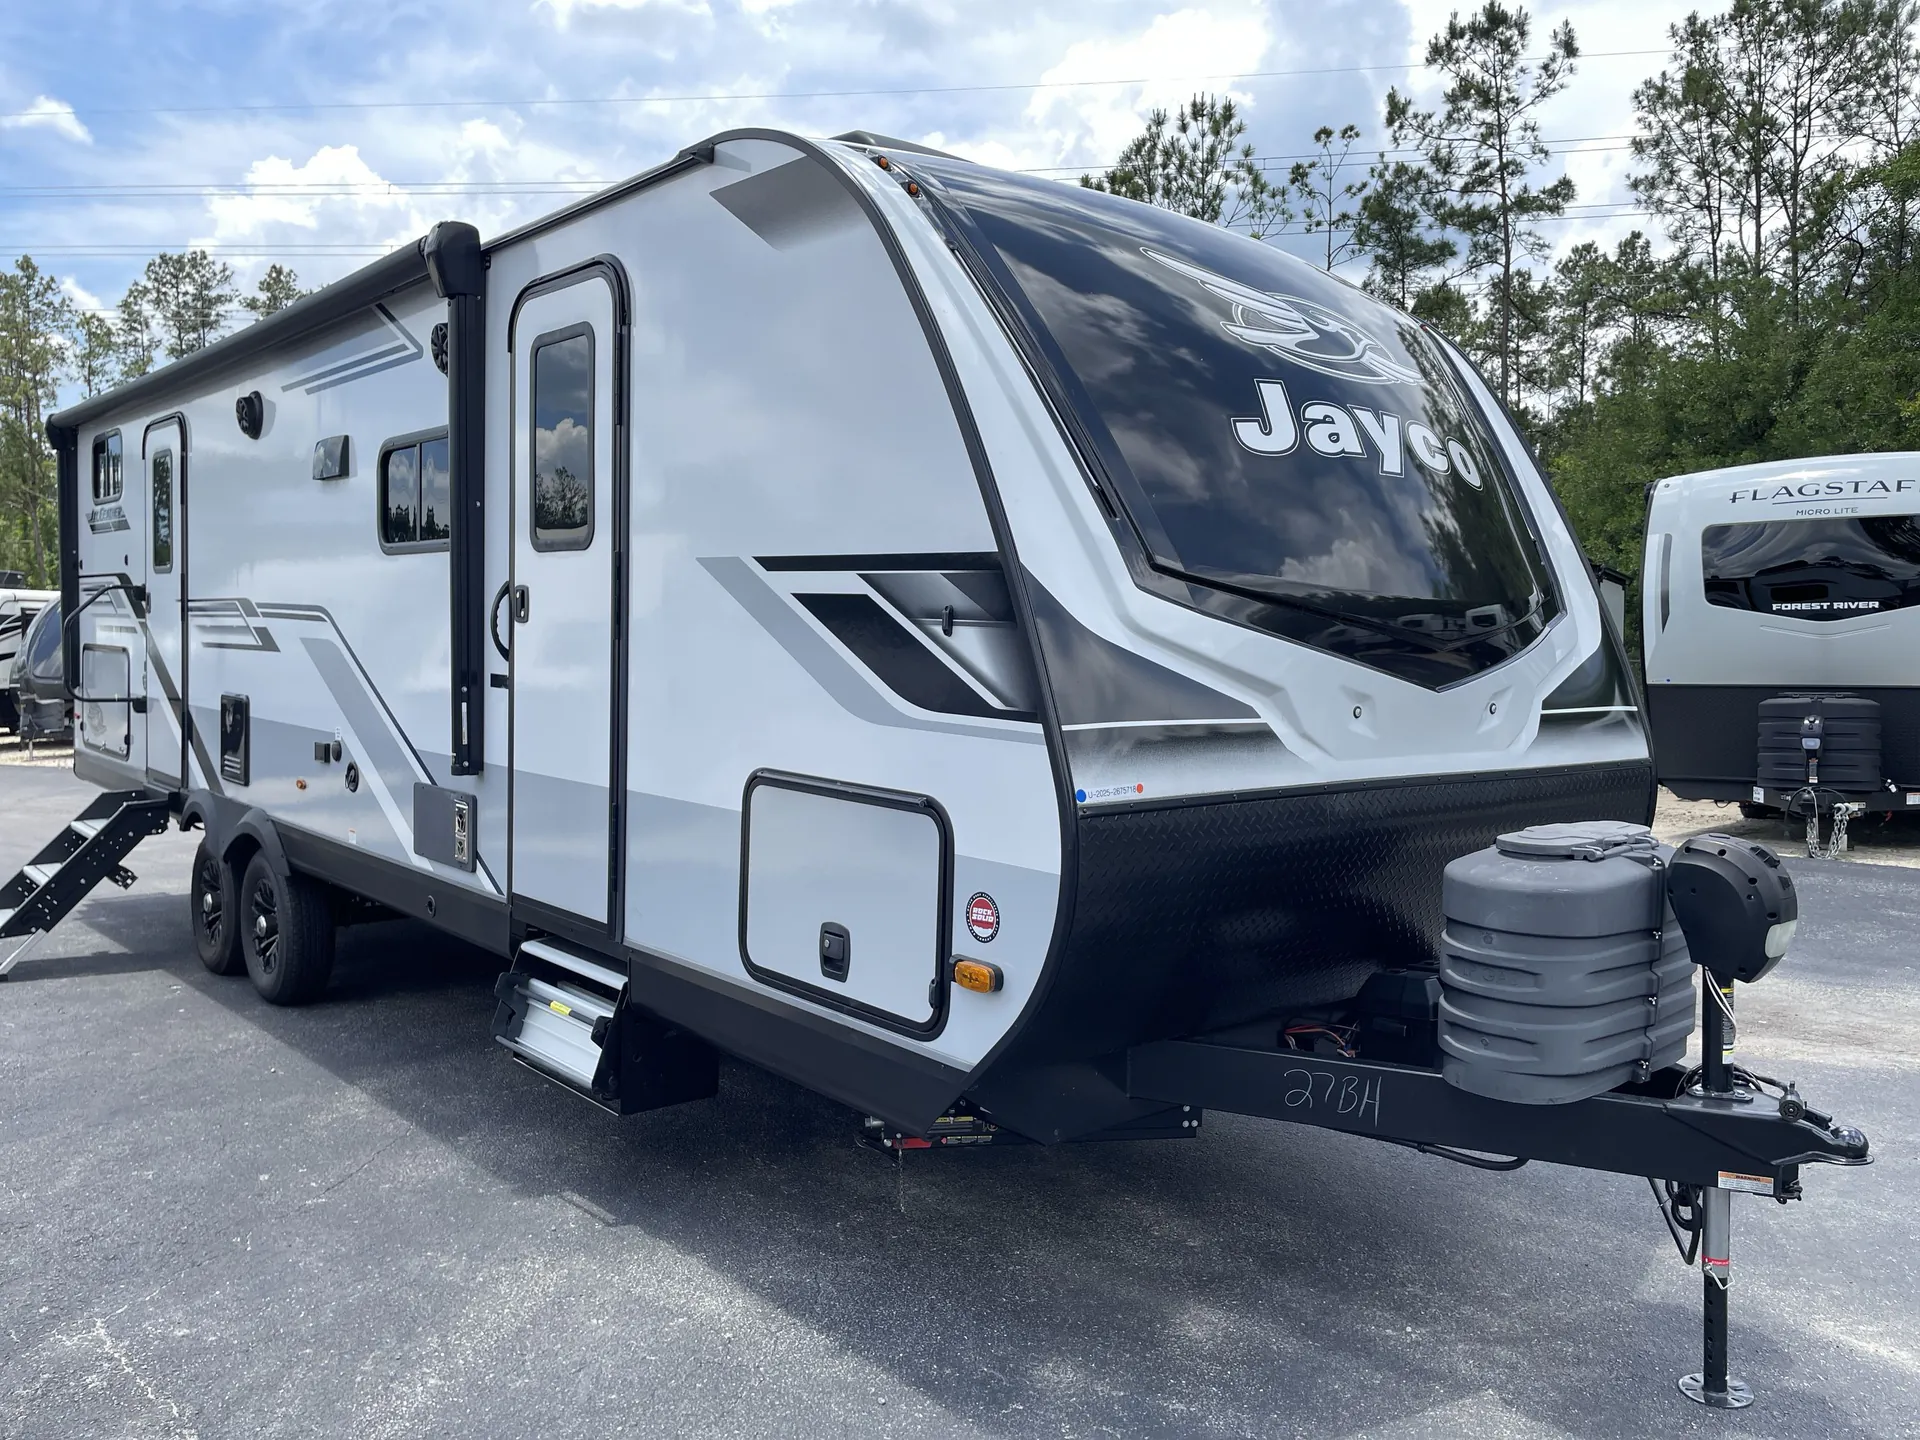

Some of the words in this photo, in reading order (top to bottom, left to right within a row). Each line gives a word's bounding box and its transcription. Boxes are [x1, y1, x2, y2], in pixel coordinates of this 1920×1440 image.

[1231, 378, 1483, 491] Jayco
[1729, 479, 1920, 503] FLAGSTAF
[1796, 508, 1831, 516] MICRO
[1834, 506, 1859, 514] LITE
[1772, 602, 1831, 611] FOREST
[1833, 601, 1880, 609] RIVER
[1283, 1068, 1382, 1128] 27BH
